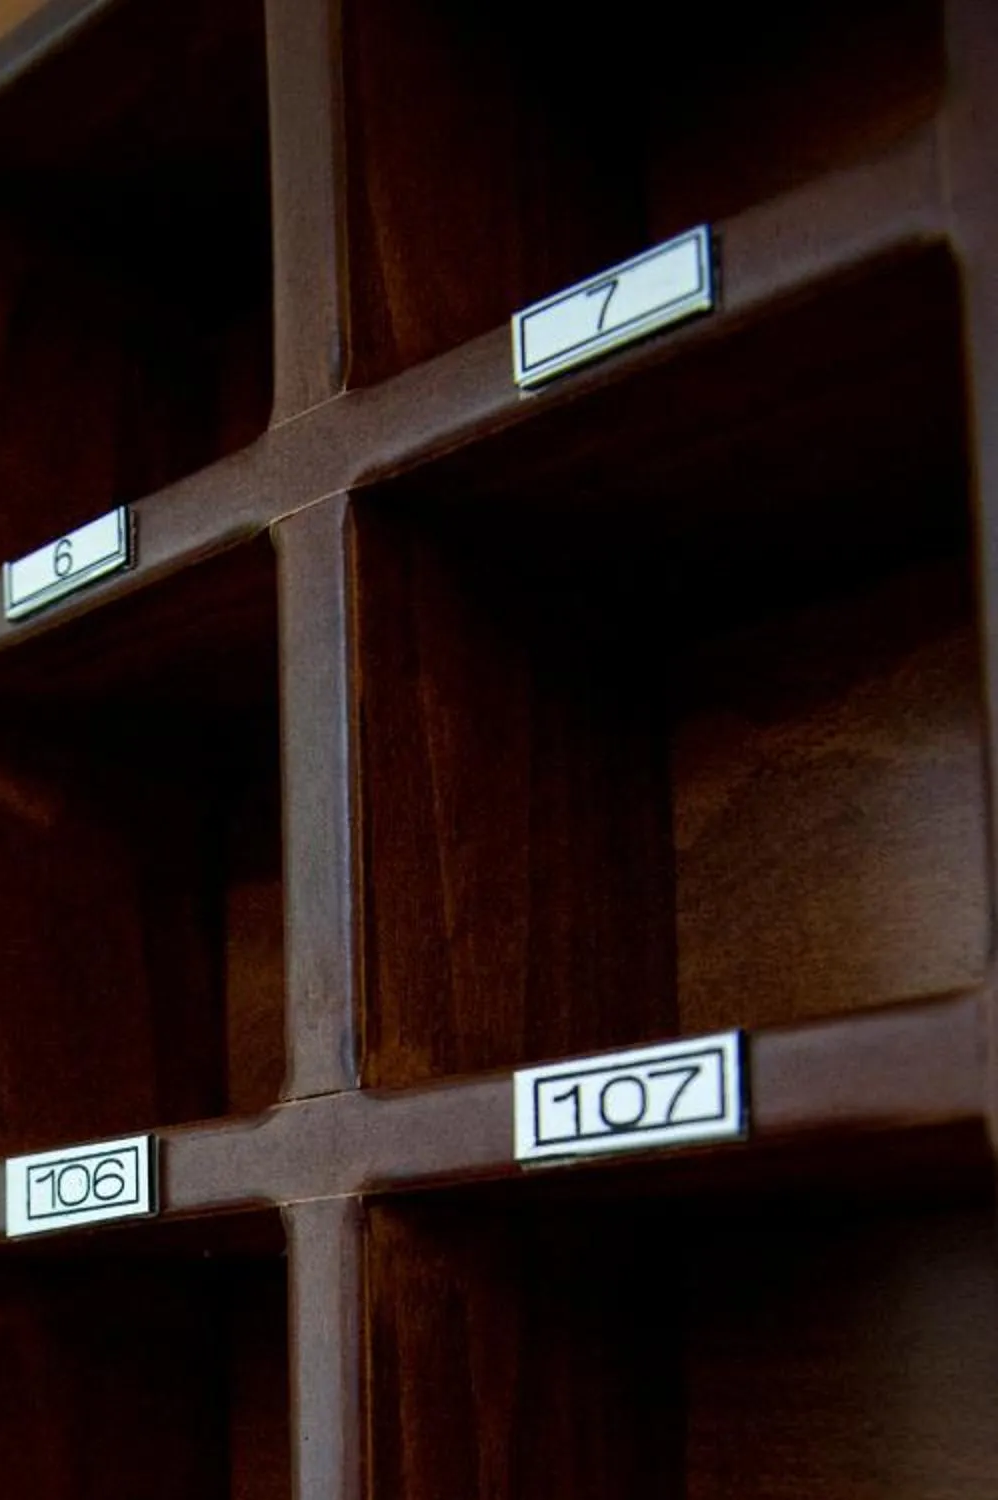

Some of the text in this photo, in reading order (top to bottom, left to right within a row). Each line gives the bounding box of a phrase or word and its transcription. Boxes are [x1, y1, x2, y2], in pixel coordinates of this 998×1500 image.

[585, 278, 619, 332] 7
[54, 538, 73, 579] 6
[552, 1066, 702, 1137] 107
[34, 1158, 126, 1209] 106
